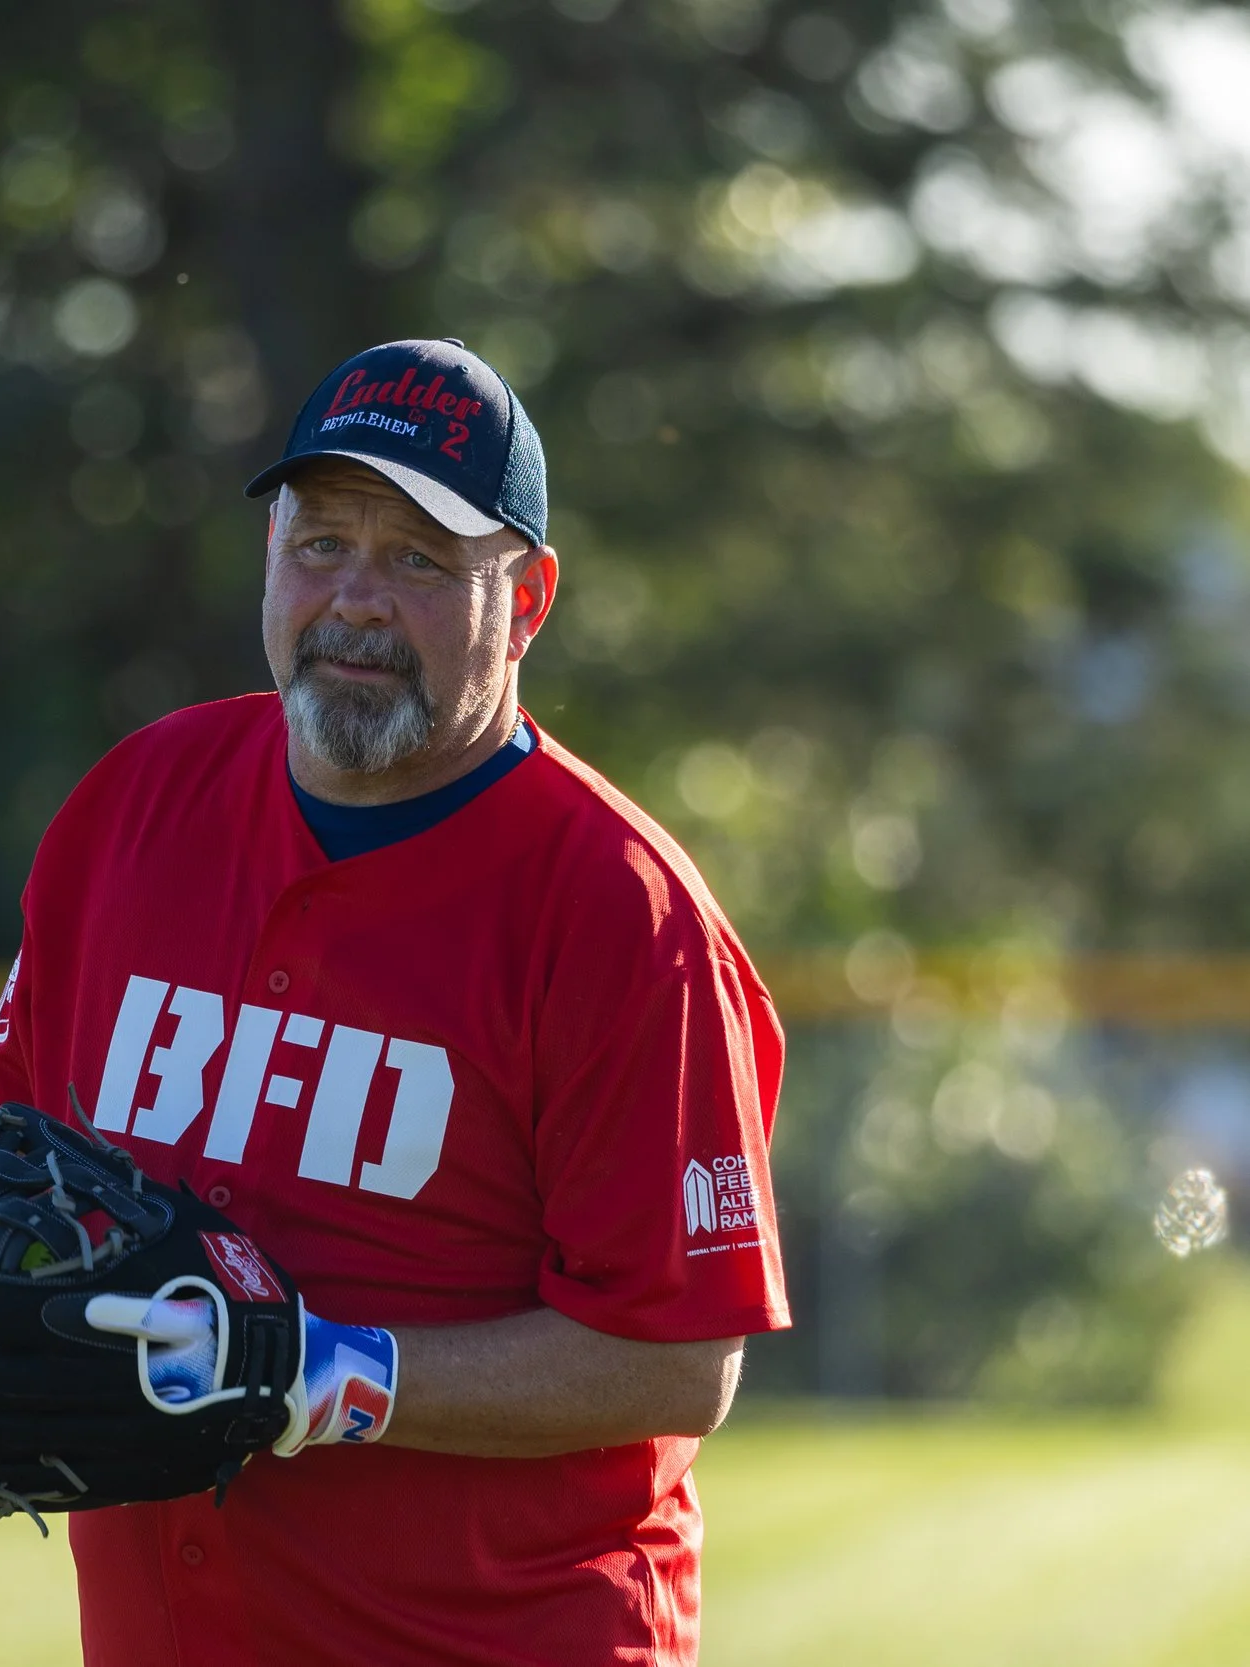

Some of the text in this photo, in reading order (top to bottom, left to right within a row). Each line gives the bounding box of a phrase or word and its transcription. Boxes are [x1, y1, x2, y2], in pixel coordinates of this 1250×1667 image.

[322, 368, 482, 420] Ladder
[320, 411, 418, 437] BETHLEHEM
[439, 420, 470, 462] 2
[93, 974, 455, 1200] BFD
